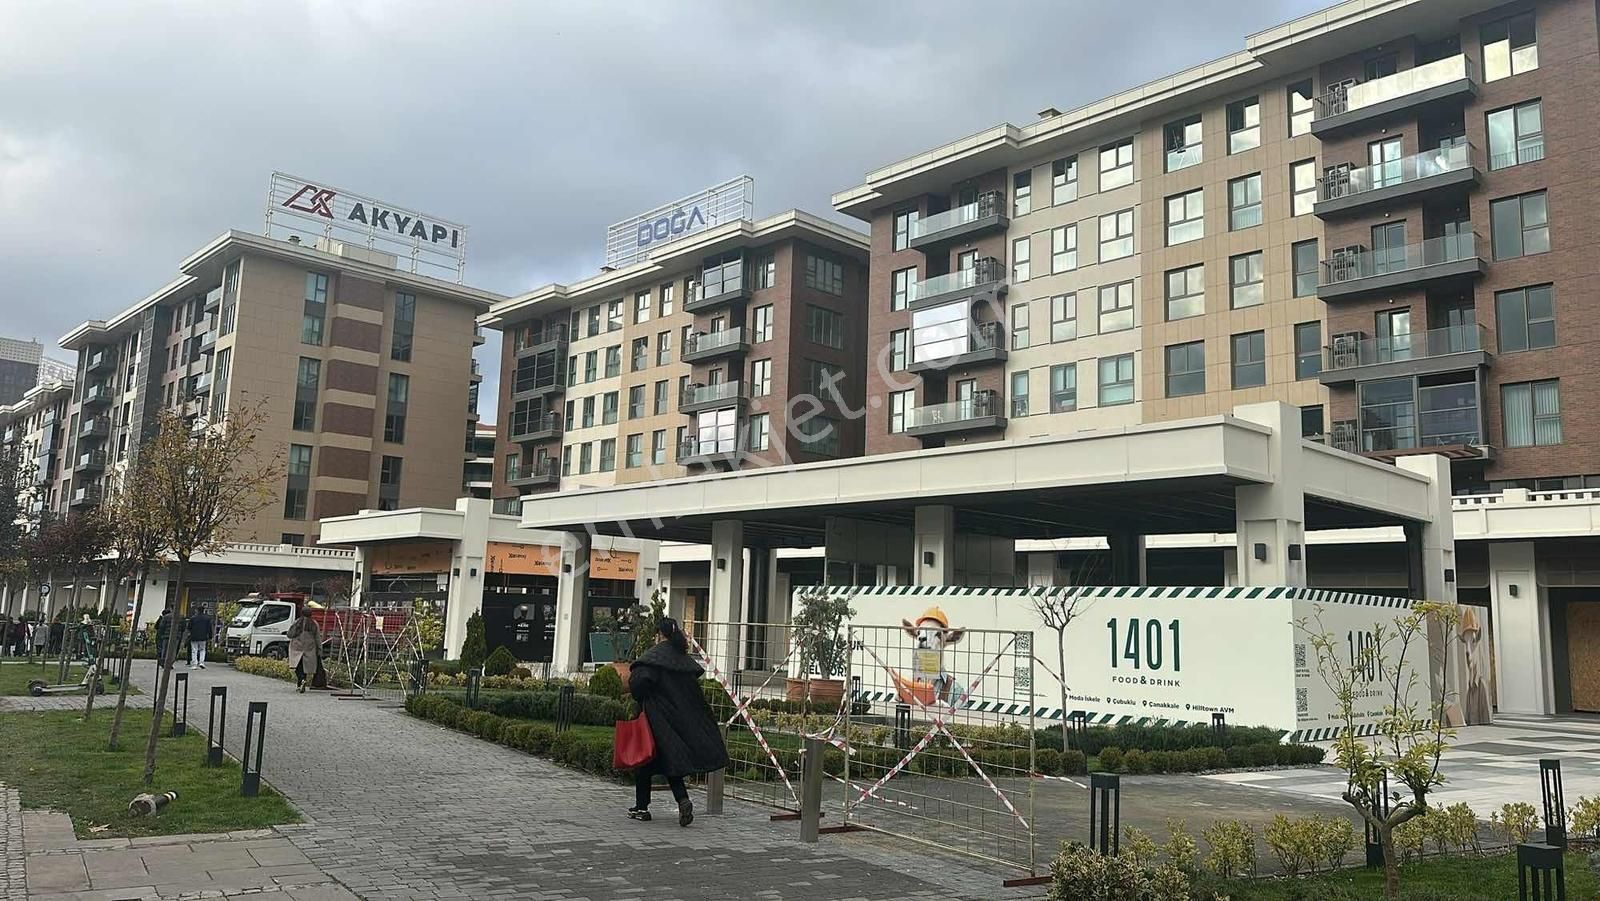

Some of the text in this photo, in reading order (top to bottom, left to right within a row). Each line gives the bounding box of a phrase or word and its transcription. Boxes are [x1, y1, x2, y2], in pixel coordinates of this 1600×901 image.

[348, 202, 458, 249] AKYAPI
[638, 206, 705, 247] DOĞA
[1107, 617, 1181, 672] 1401
[1112, 675, 1181, 687] FOOD & DRINK
[1192, 704, 1235, 714] Hilltown AVM
